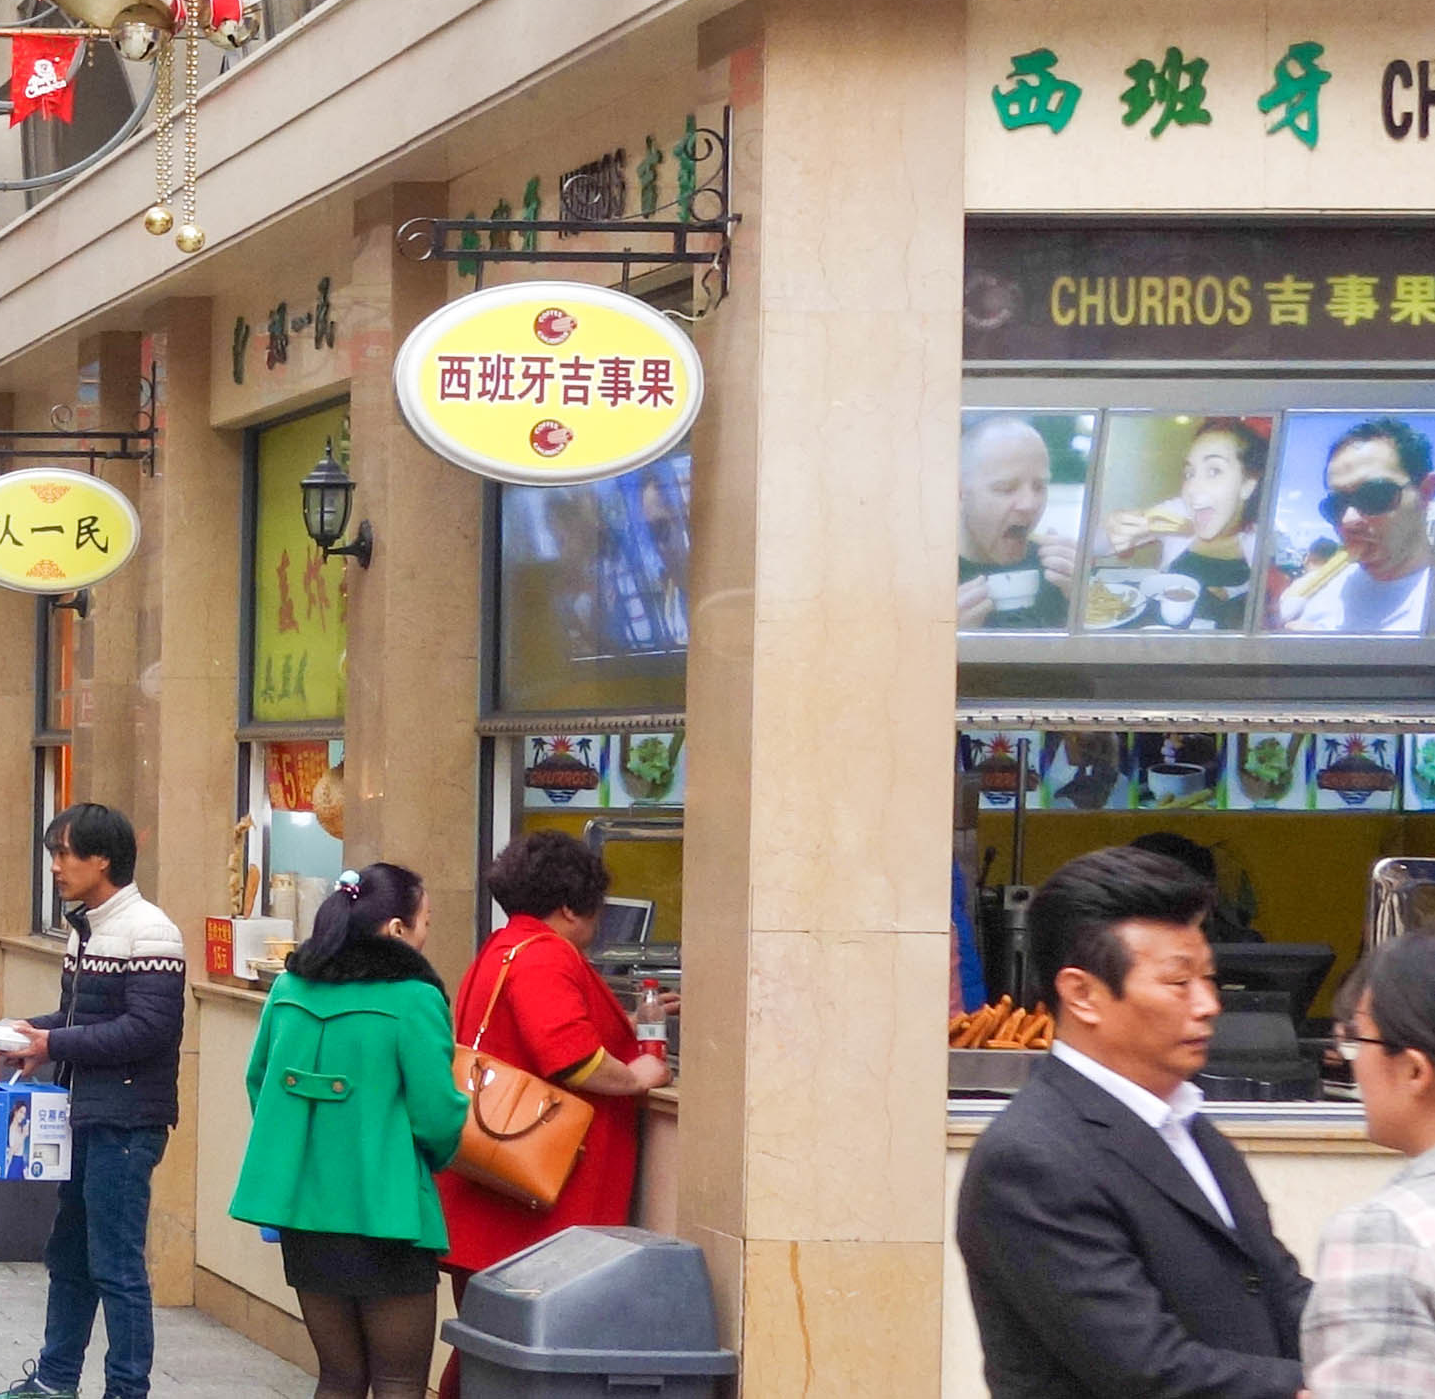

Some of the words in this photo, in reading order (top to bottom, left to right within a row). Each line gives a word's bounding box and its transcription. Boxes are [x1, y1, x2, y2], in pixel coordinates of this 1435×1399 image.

[991, 41, 1332, 150] 西班牙
[1050, 275, 1253, 327] CHURROS
[1264, 273, 1435, 327] 吉事果
[438, 353, 676, 409] 西班牙吉事果
